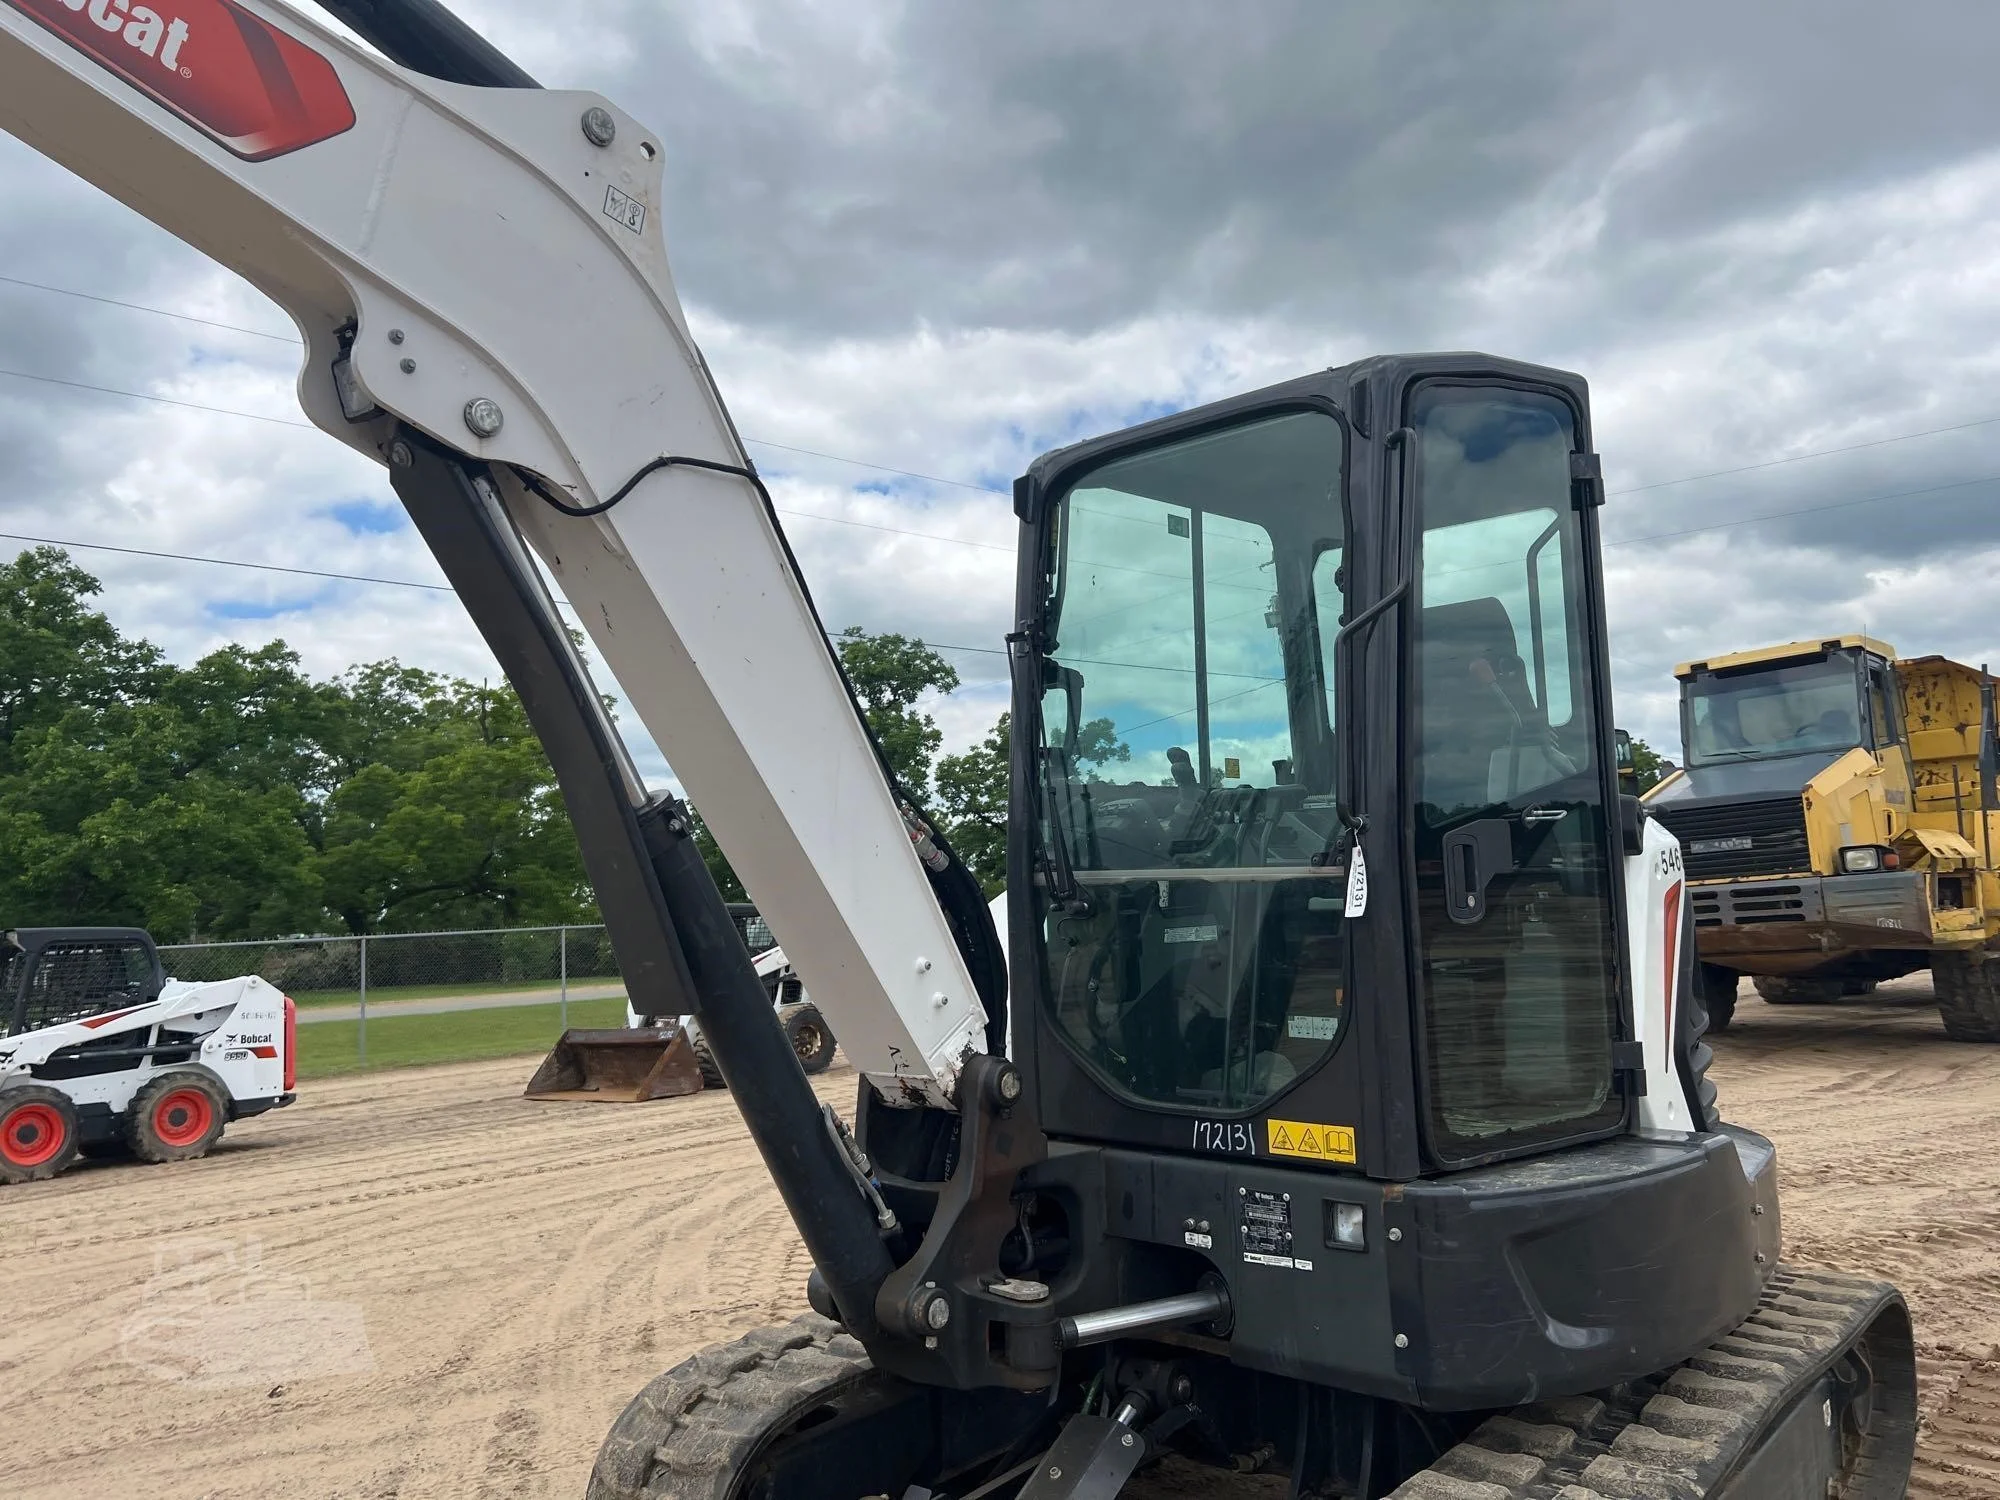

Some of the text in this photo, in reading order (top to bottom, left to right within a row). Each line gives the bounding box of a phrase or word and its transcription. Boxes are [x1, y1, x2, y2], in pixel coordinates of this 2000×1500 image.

[1353, 863, 1364, 908] 172131
[240, 1033, 272, 1044] Bobcat
[1193, 1119, 1256, 1155] 172131
